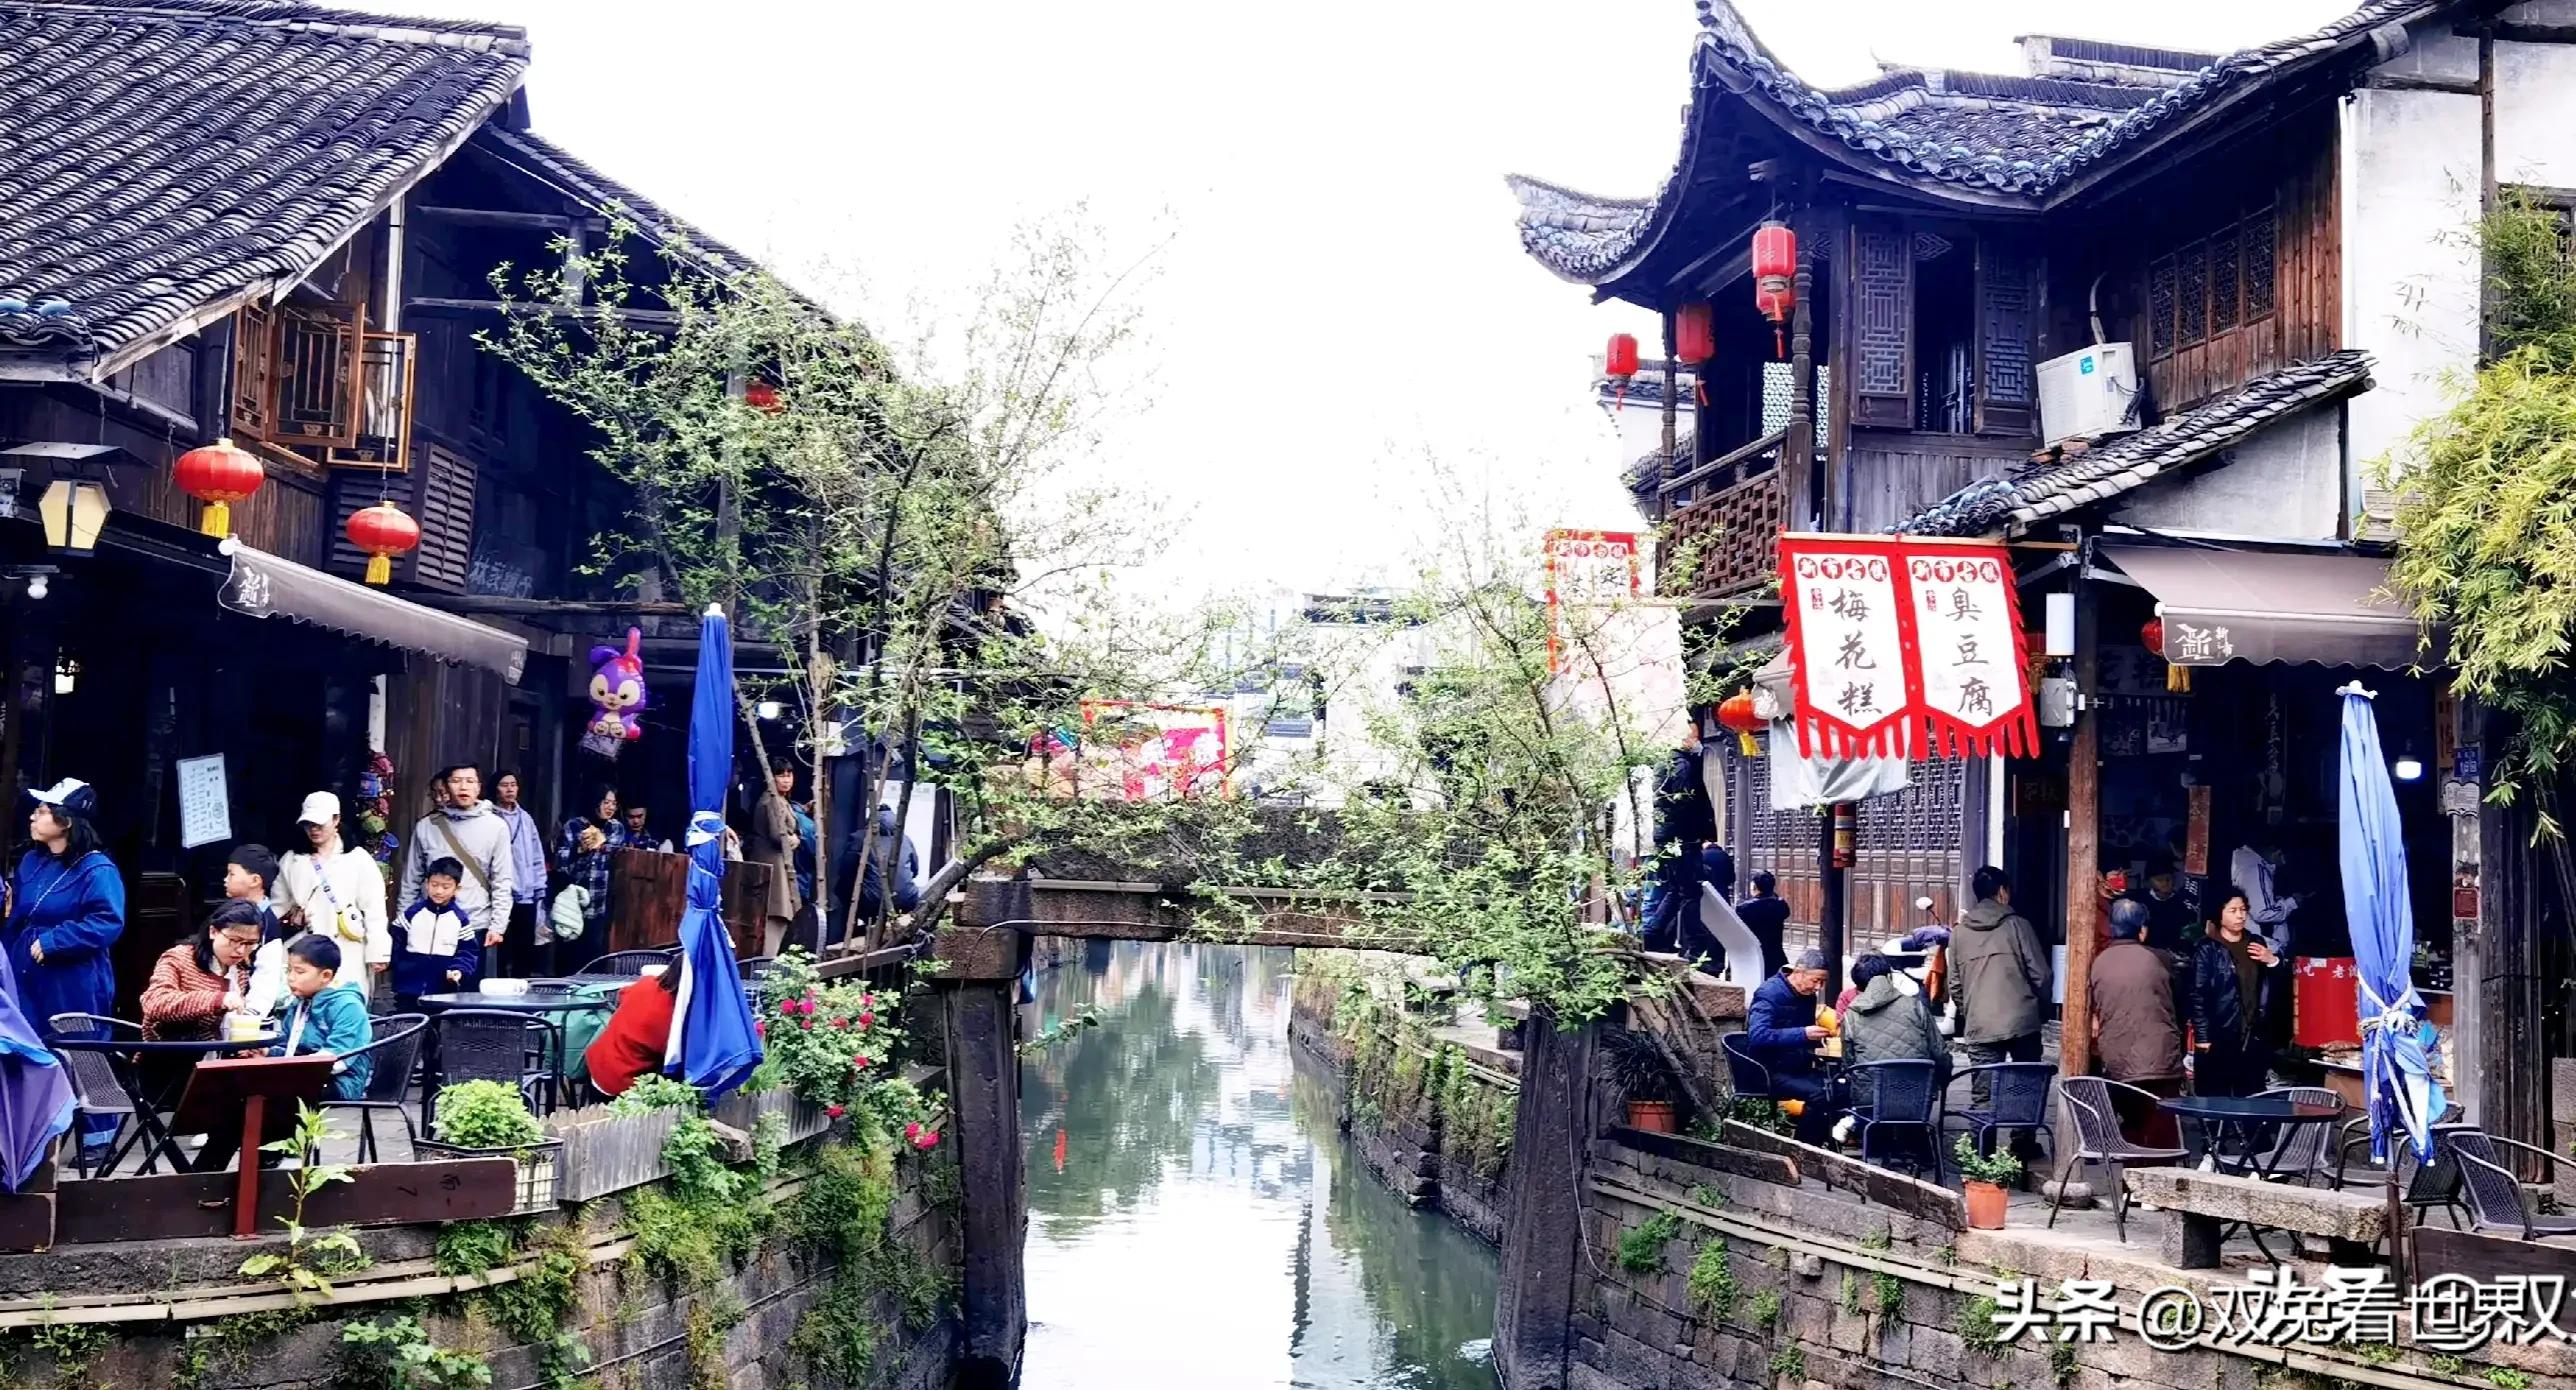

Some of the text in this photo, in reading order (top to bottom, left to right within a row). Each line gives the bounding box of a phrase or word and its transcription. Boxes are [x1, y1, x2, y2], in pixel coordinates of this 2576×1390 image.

[1828, 587, 1883, 716] 梅花糕
[1945, 586, 1993, 717] 臭豆腐
